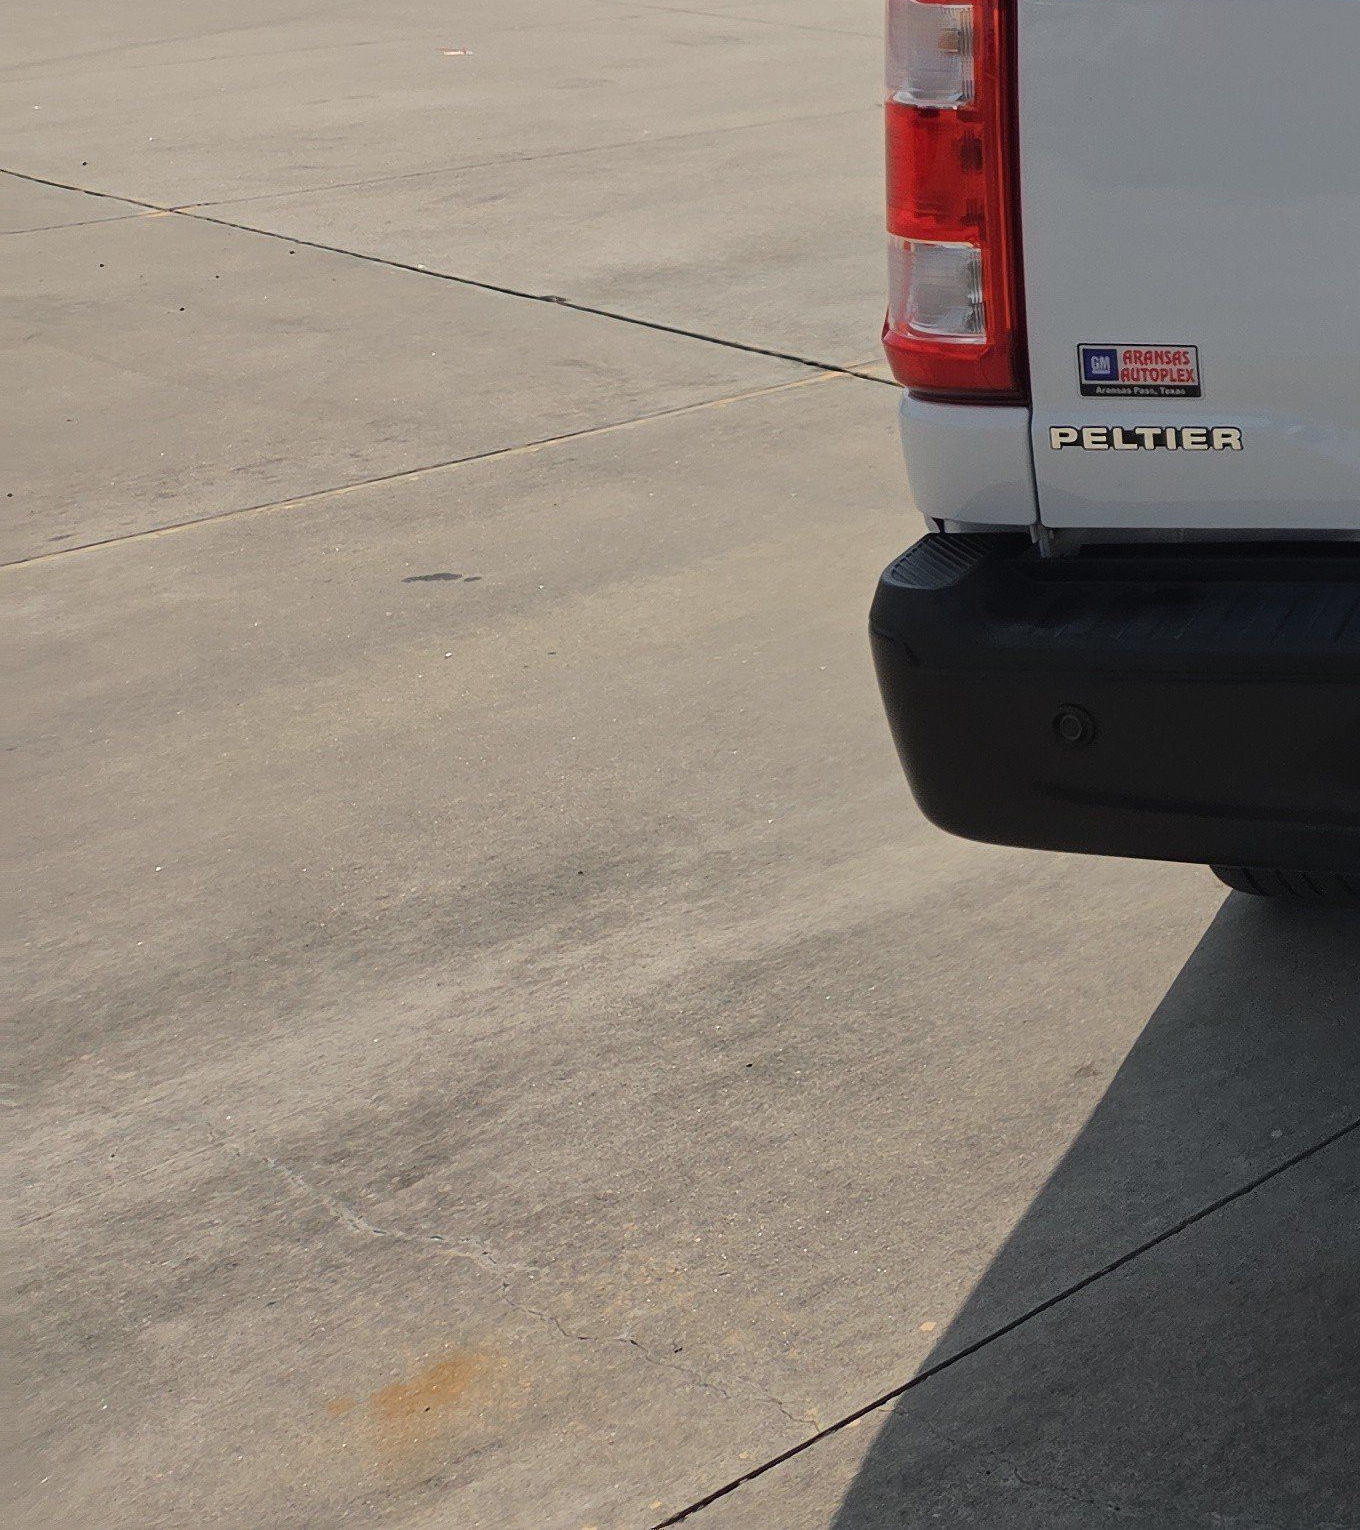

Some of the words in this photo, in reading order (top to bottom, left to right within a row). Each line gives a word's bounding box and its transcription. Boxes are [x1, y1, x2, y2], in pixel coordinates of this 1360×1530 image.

[1090, 355, 1111, 374] GM
[1122, 349, 1190, 366] ARANSAS
[1120, 367, 1195, 383] AUTOPLEX
[1050, 426, 1244, 451] PELTIER
